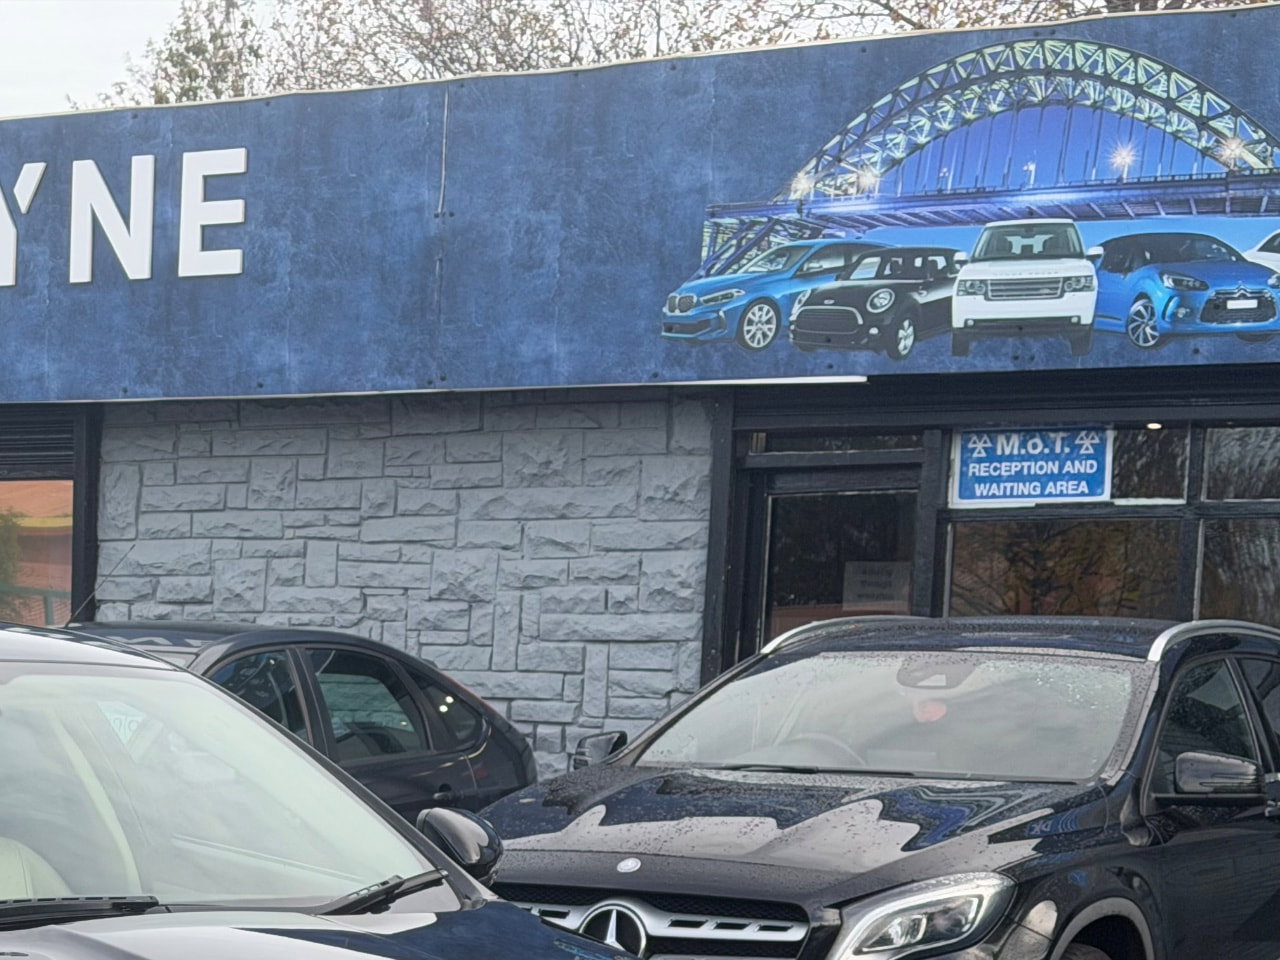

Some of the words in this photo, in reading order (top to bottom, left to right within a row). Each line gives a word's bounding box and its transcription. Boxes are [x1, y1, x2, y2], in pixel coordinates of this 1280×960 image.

[968, 461, 1059, 477] RECEPTION
[1062, 459, 1098, 474] AND
[974, 481, 1041, 497] WAITING
[1044, 480, 1089, 495] AREA
